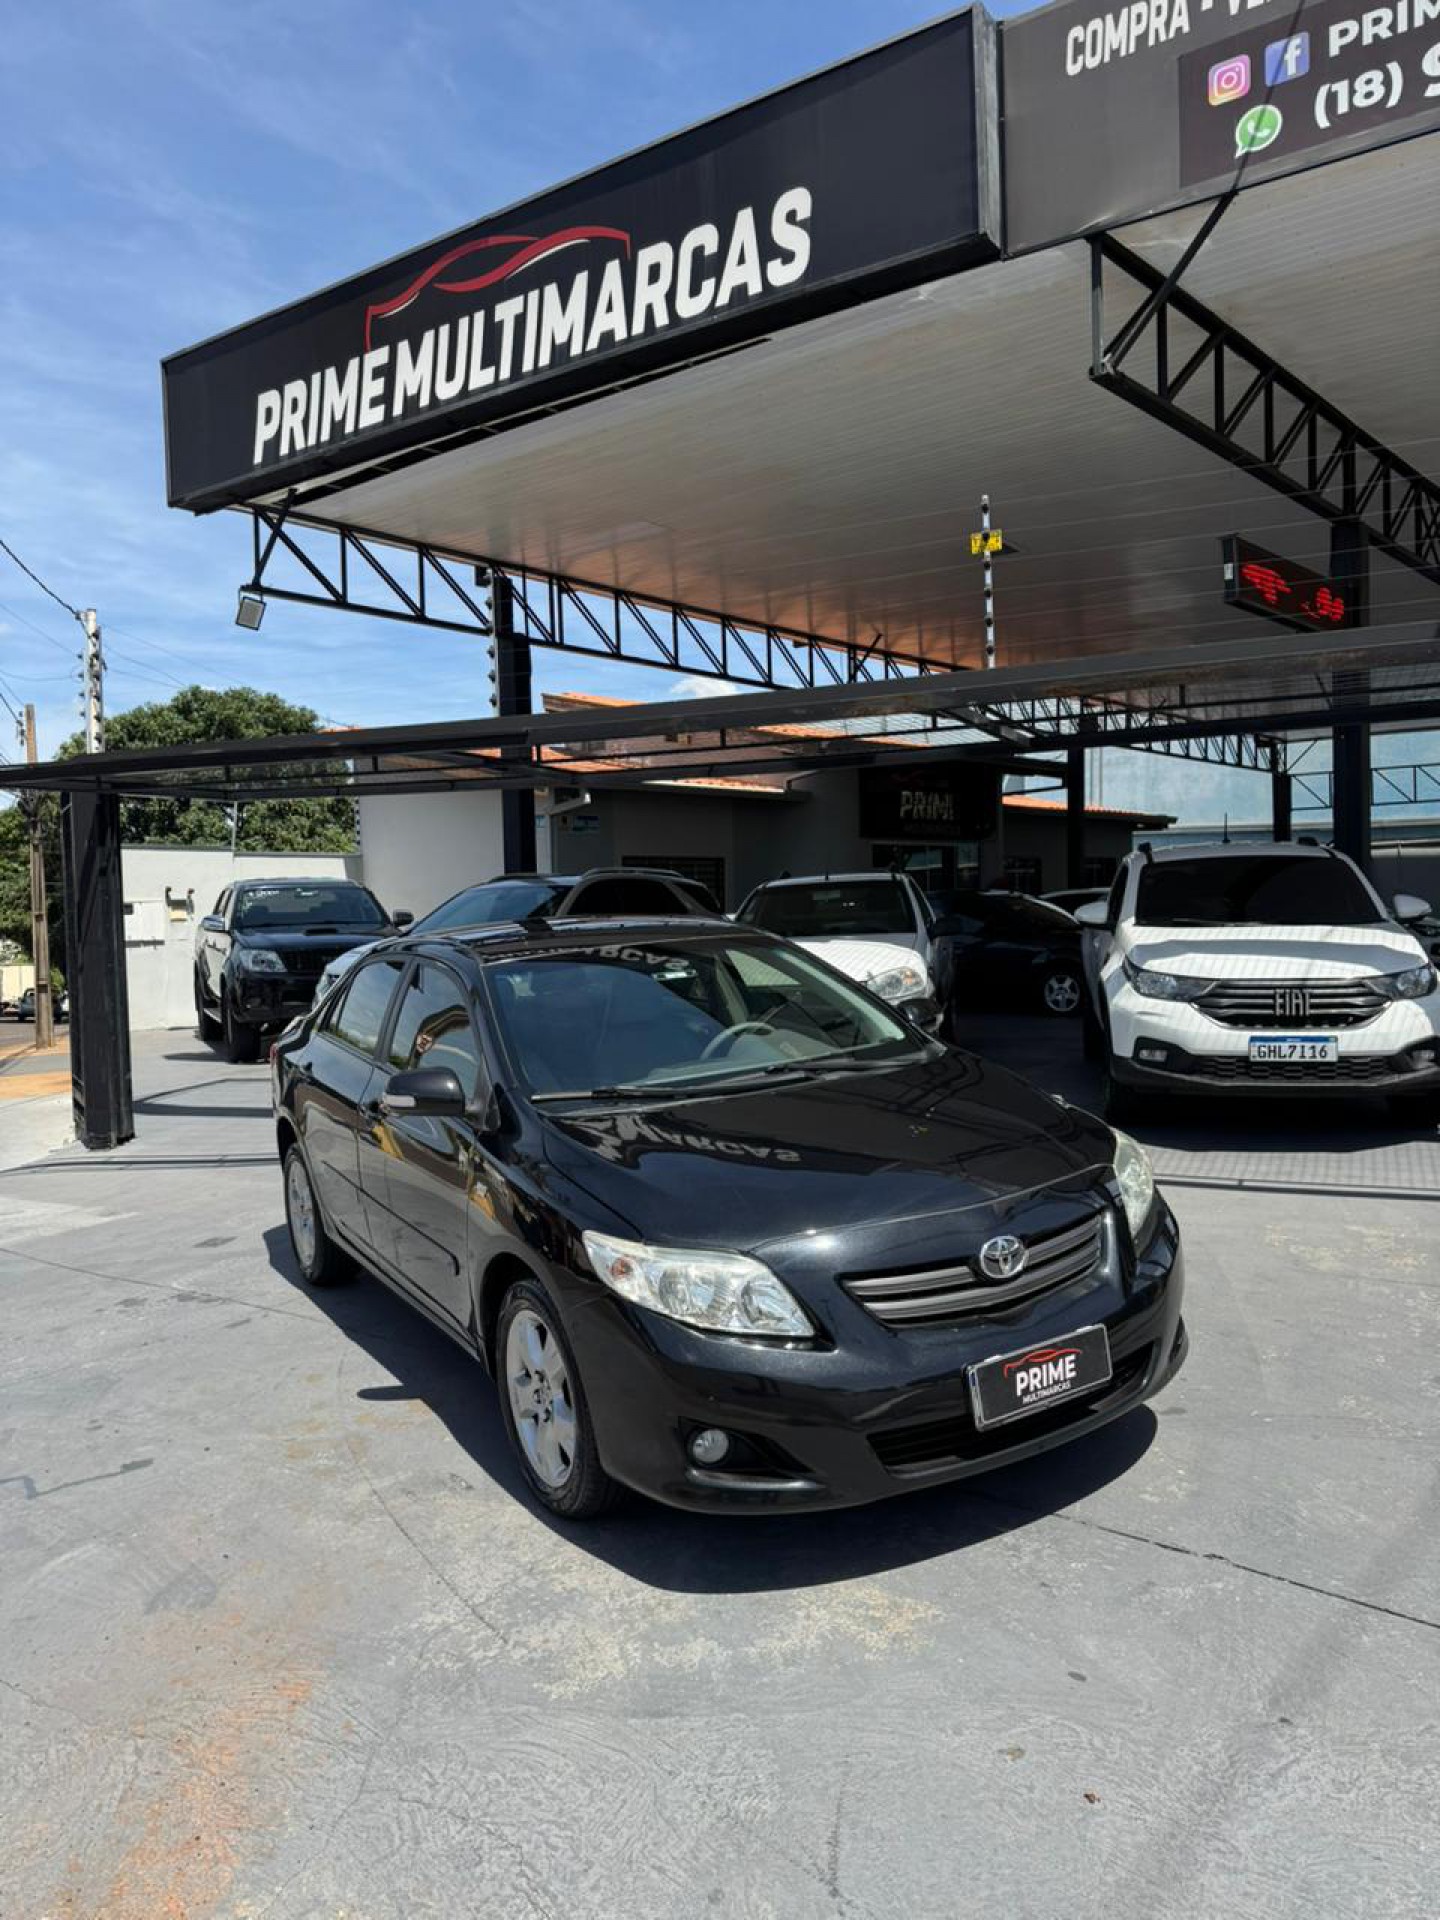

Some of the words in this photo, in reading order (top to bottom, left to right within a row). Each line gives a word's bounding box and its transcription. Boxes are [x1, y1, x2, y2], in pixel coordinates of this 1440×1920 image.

[1065, 0, 1191, 76] COMPRA
[1314, 61, 1404, 129] (18)
[1275, 988, 1312, 1016] FIAT
[1016, 1354, 1077, 1397] PRIME
